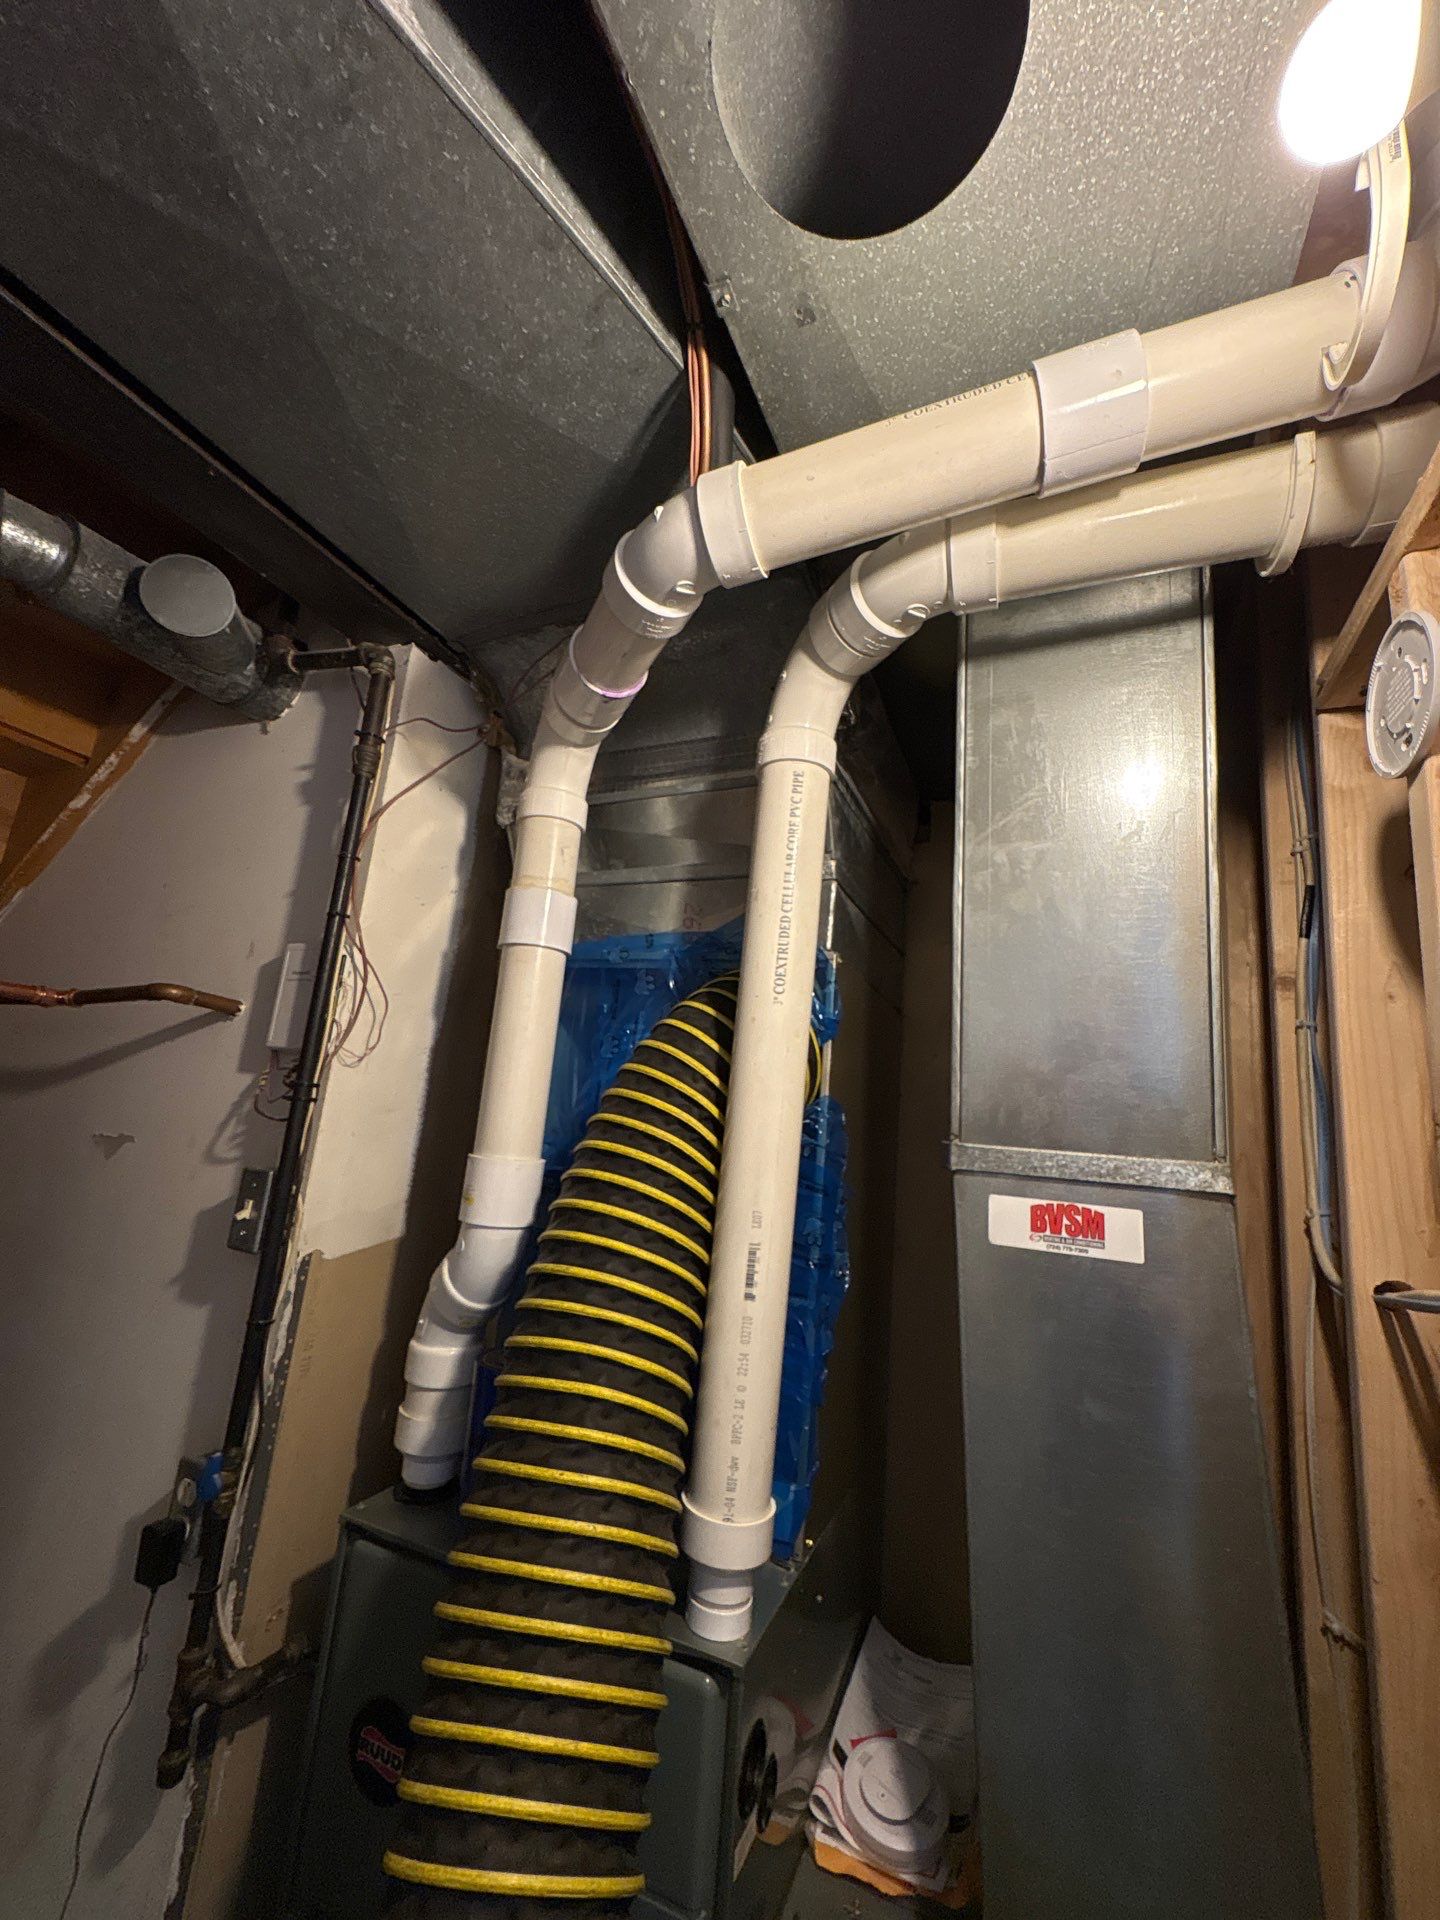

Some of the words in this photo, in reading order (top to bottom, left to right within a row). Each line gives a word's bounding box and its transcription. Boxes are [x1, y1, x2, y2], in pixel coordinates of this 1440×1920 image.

[903, 382, 1001, 420] COEXTRUDED
[792, 770, 805, 795] PIPE
[789, 797, 803, 818] PVC
[785, 820, 801, 852] CORE
[774, 915, 792, 995] COEXTRUDED
[1030, 1203, 1105, 1240] BVSM
